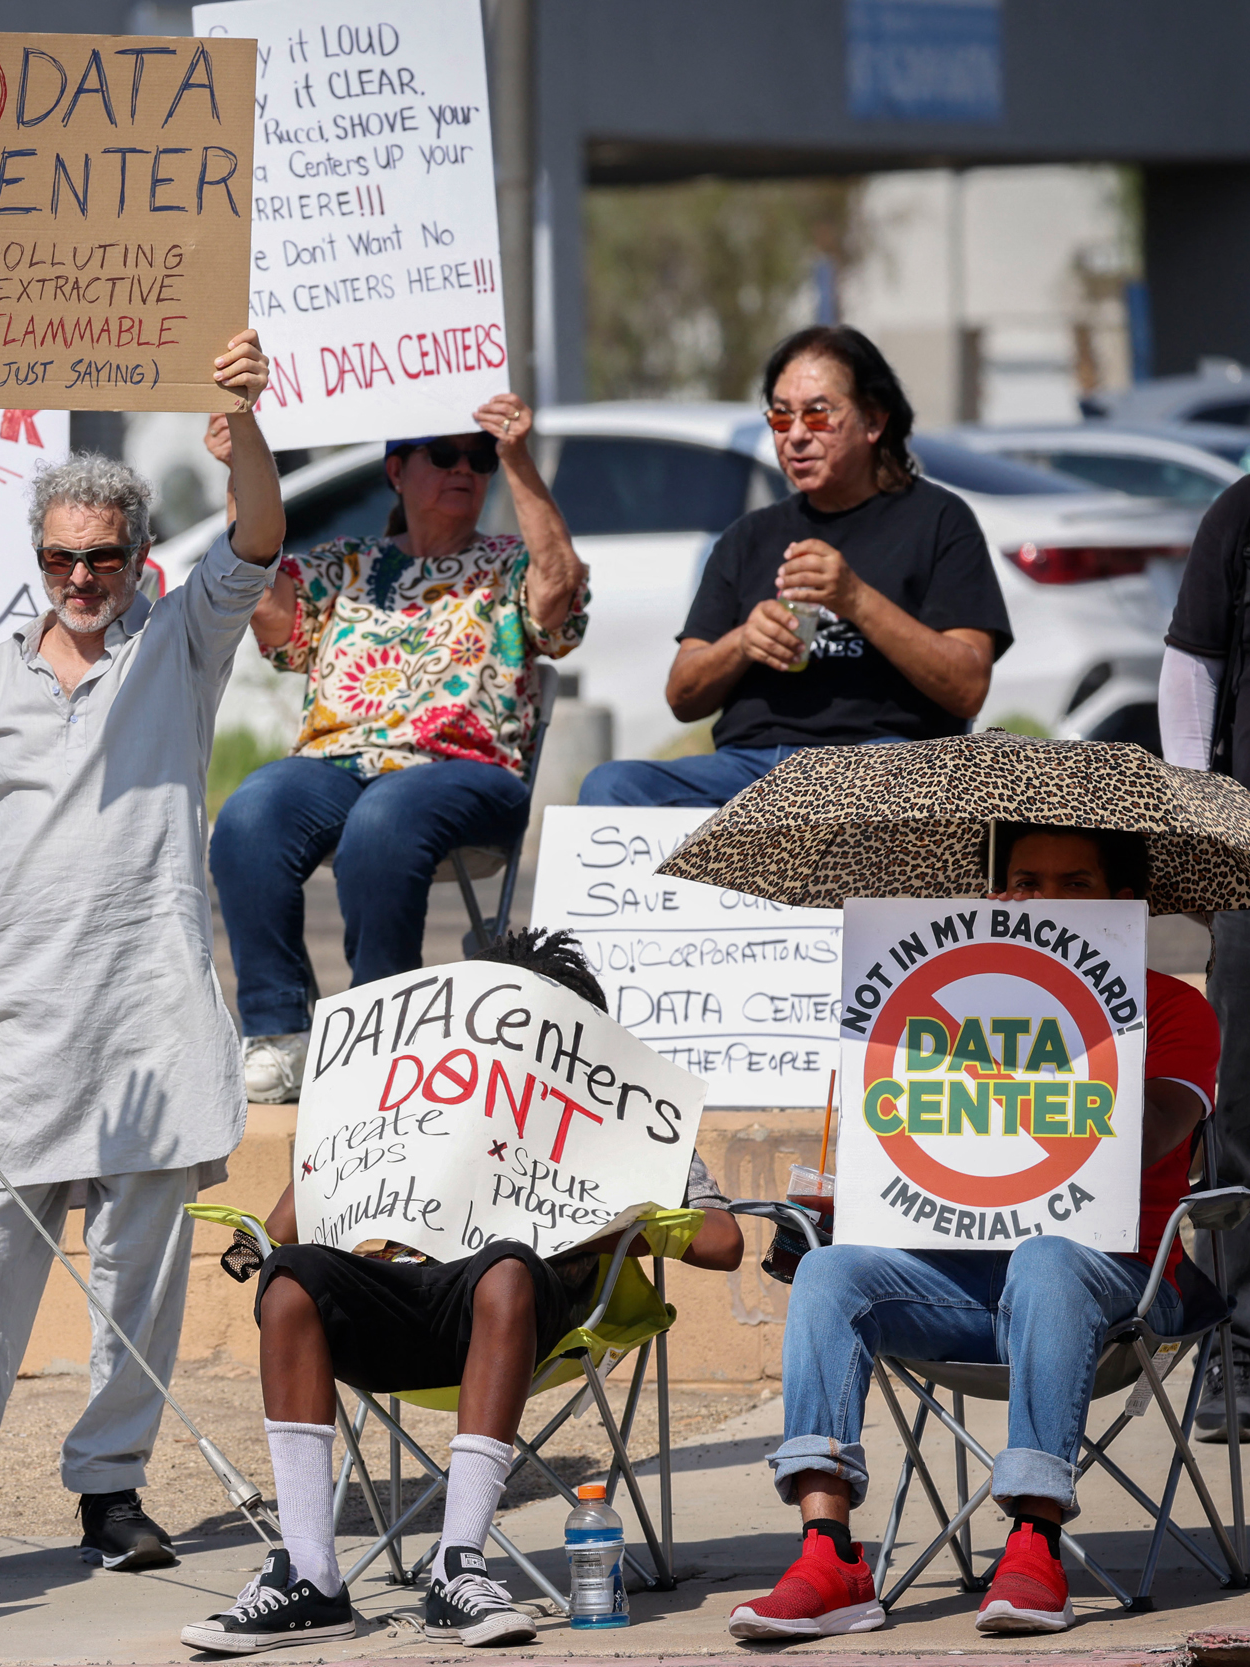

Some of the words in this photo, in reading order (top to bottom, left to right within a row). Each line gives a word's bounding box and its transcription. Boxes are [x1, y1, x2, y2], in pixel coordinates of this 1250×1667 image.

[288, 28, 310, 63] it
[321, 22, 400, 59] LOUD
[17, 41, 221, 130] DATA
[294, 72, 316, 108] it
[328, 67, 425, 100] CLEAR.
[333, 106, 419, 140] SHOVE
[429, 104, 480, 140] your
[289, 150, 370, 178] Centers
[419, 144, 474, 174] your
[254, 250, 270, 271] e
[282, 233, 337, 267] Don't
[347, 223, 402, 258] Want
[421, 221, 455, 249] No
[293, 274, 395, 312] CENTERS
[407, 258, 495, 294] HERE!!!
[65, 358, 160, 390] SAYING)
[253, 352, 304, 413] AN
[320, 341, 395, 397] DATA
[398, 323, 507, 380] CENTERS
[577, 826, 690, 868] SAV
[567, 882, 680, 916] SAVE
[841, 961, 895, 1035] NOT
[888, 931, 929, 972] IN
[930, 909, 979, 949] MY
[990, 908, 1145, 1036] BACKYARD!
[313, 976, 455, 1083] DATA
[617, 985, 722, 1029] DATA
[722, 1042, 821, 1077] PEOPLE
[905, 1016, 1075, 1075] DATA
[862, 1077, 1118, 1138] CENTER
[313, 1105, 450, 1172] create
[879, 1175, 1044, 1241] IMPERIAL,
[1048, 1181, 1096, 1222] CA
